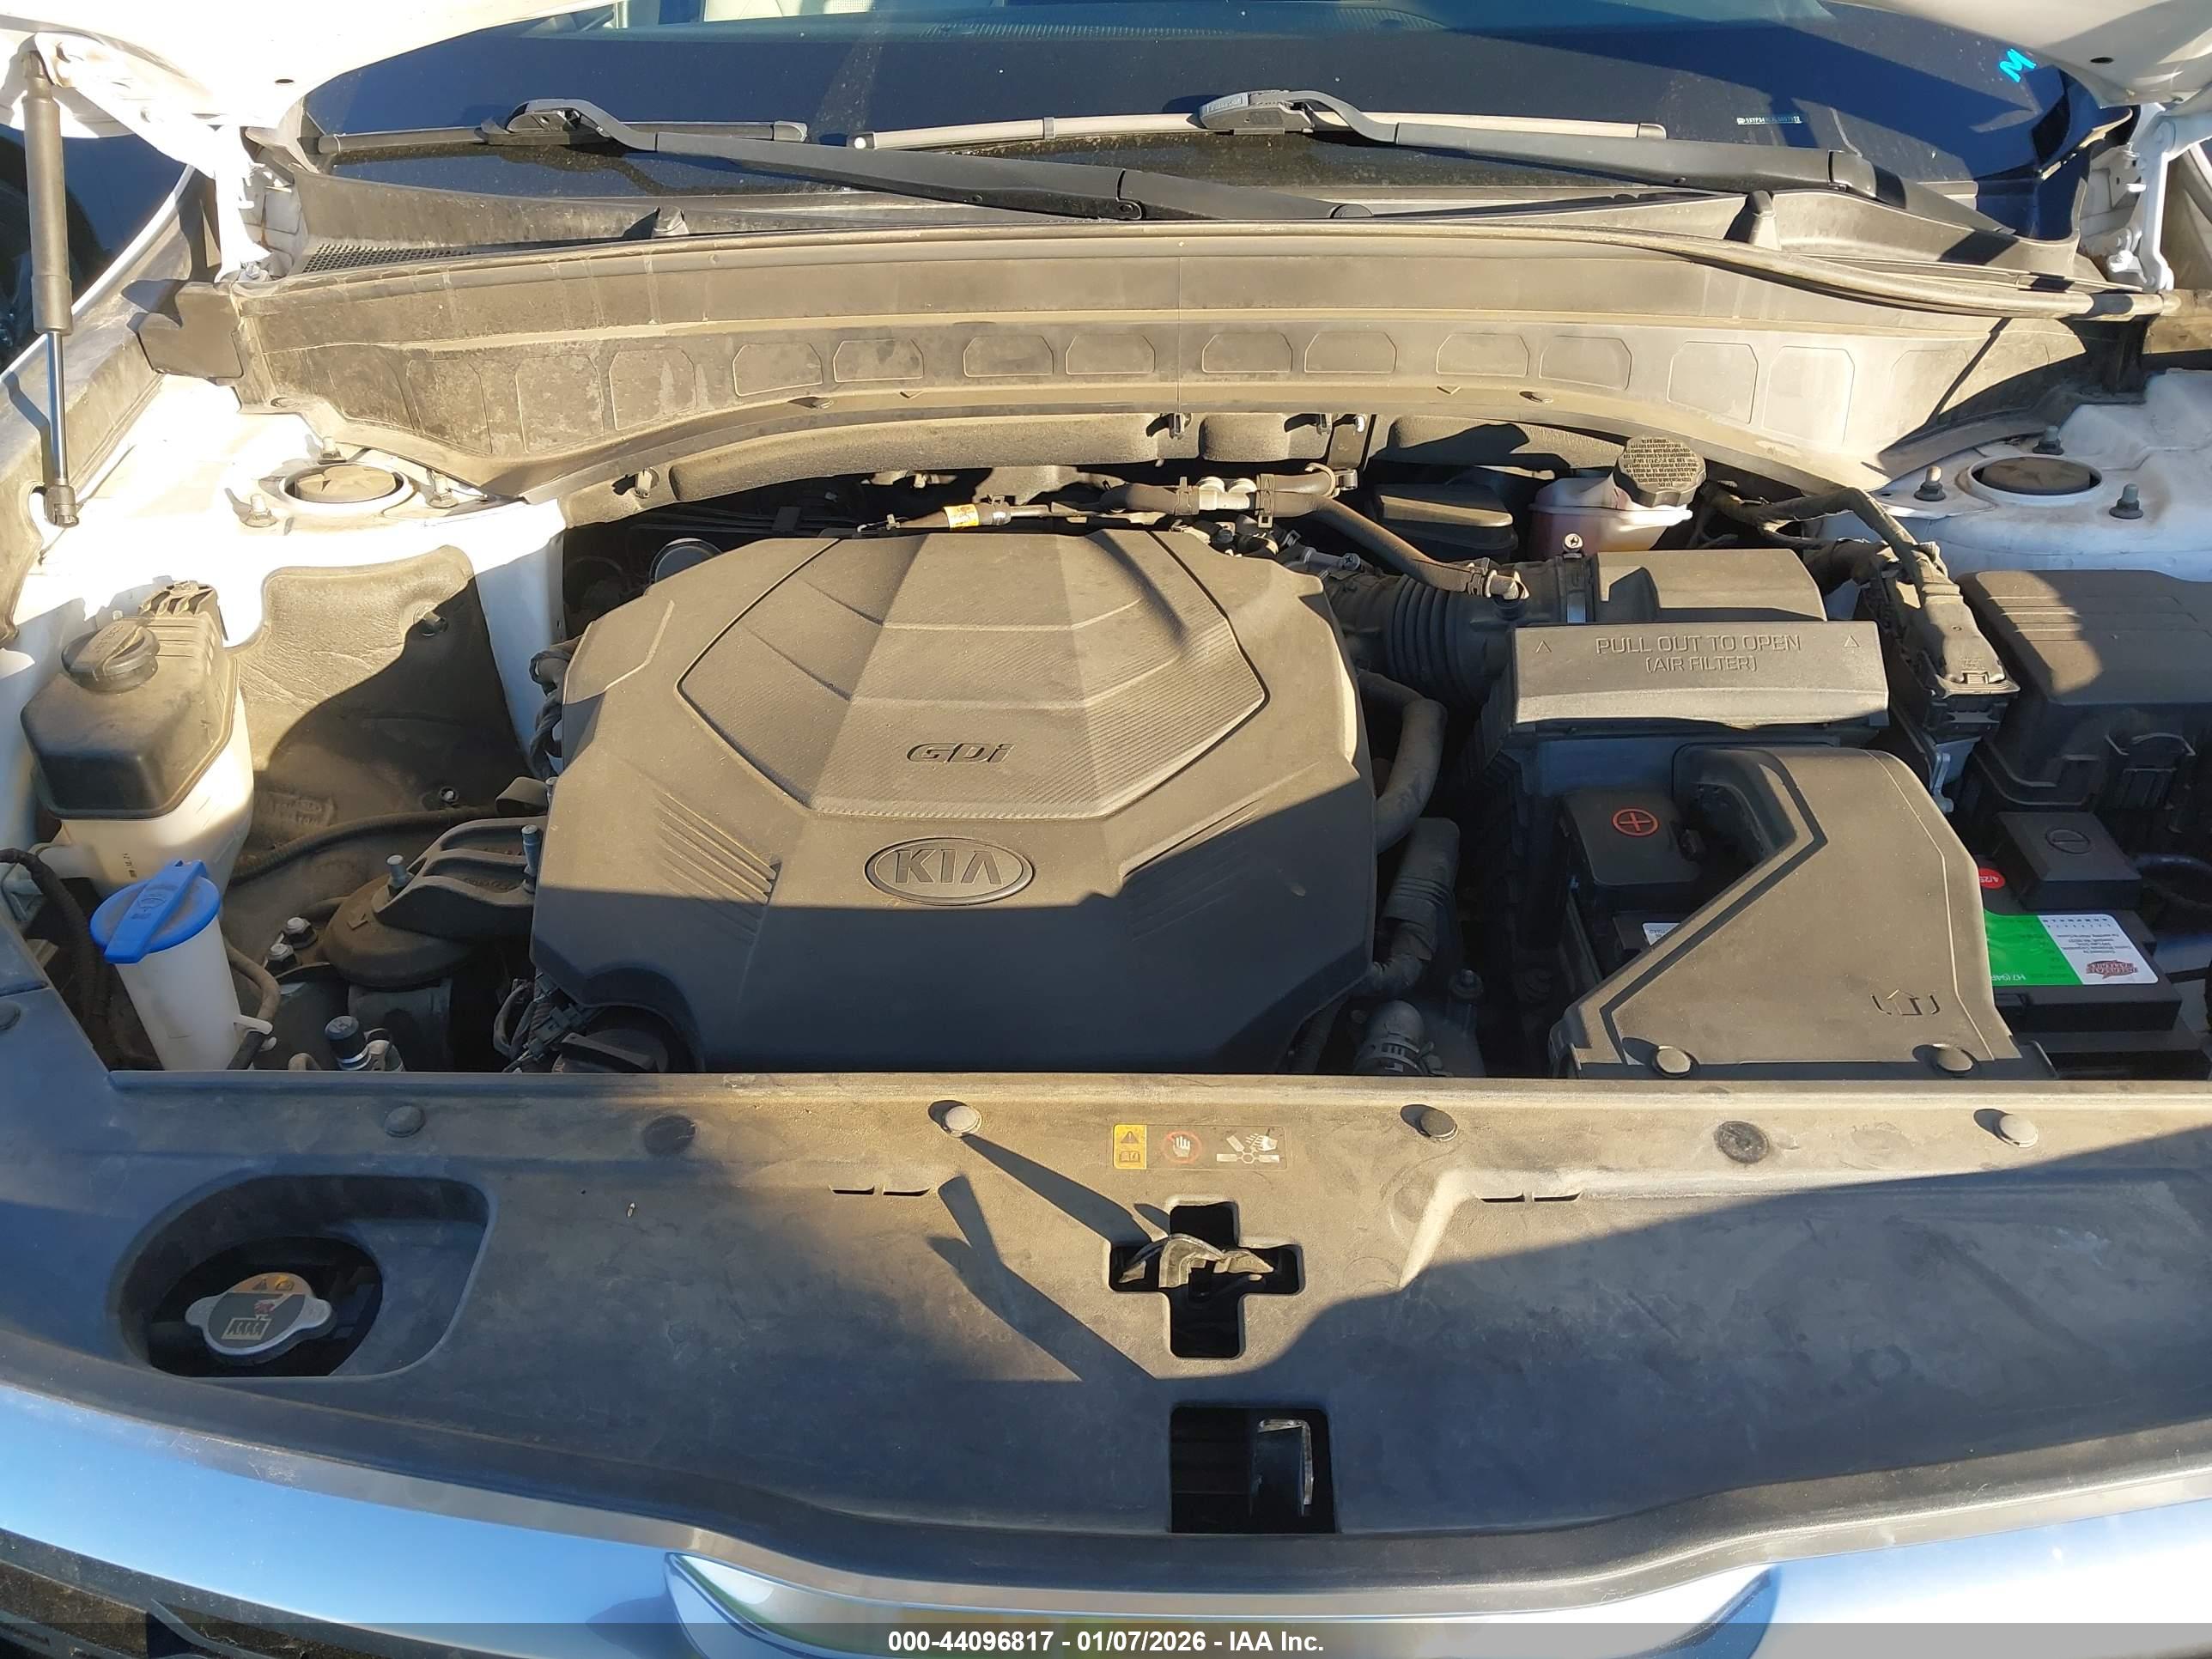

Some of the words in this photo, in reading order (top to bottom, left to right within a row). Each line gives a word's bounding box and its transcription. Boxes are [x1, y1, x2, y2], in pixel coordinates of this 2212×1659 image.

[1595, 637, 1652, 653] PULL
[1657, 635, 1701, 653] OUT
[1706, 635, 1736, 653] TO
[1741, 634, 1802, 653] OPEN
[1645, 656, 1685, 673] (AIR
[1689, 654, 1758, 672] FILTER)
[906, 743, 1015, 763] GDi
[895, 848, 1004, 885] KIA
